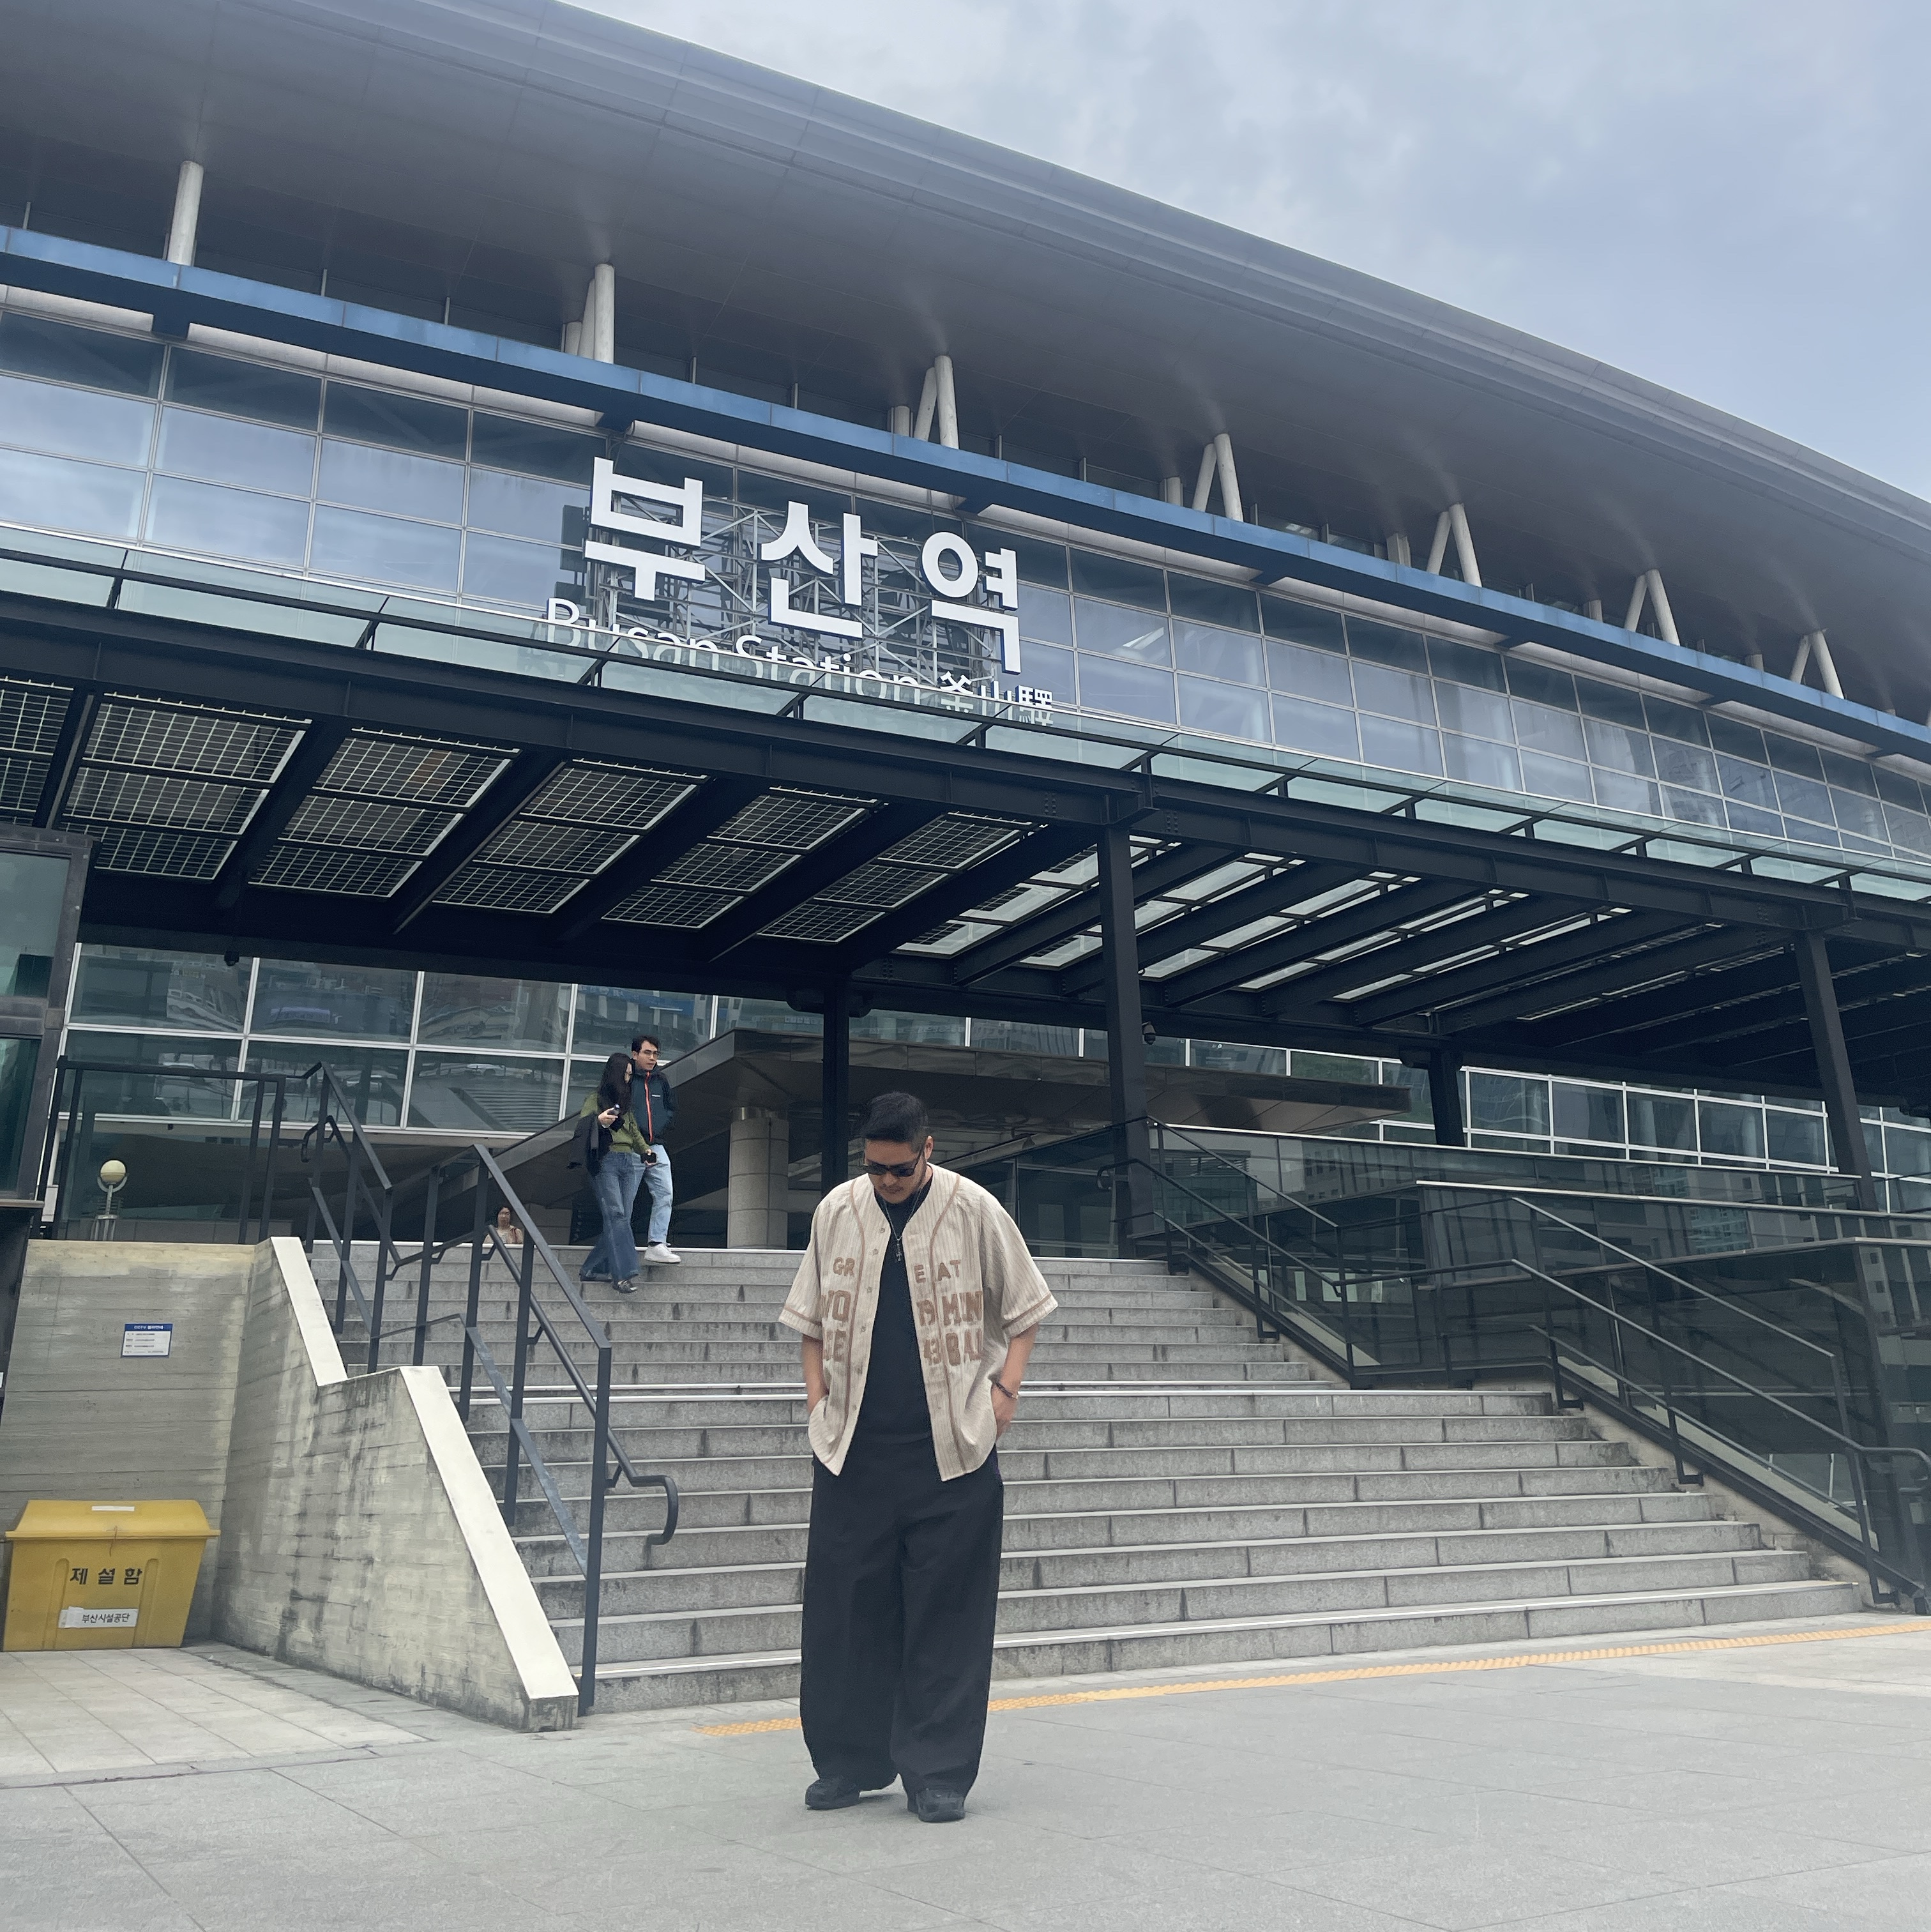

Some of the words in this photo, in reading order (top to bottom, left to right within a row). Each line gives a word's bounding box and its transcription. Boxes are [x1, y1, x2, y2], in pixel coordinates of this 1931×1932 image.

[547, 598, 718, 671] Busan
[735, 635, 920, 704] Station
[82, 1613, 130, 1623] 부산시설공단
